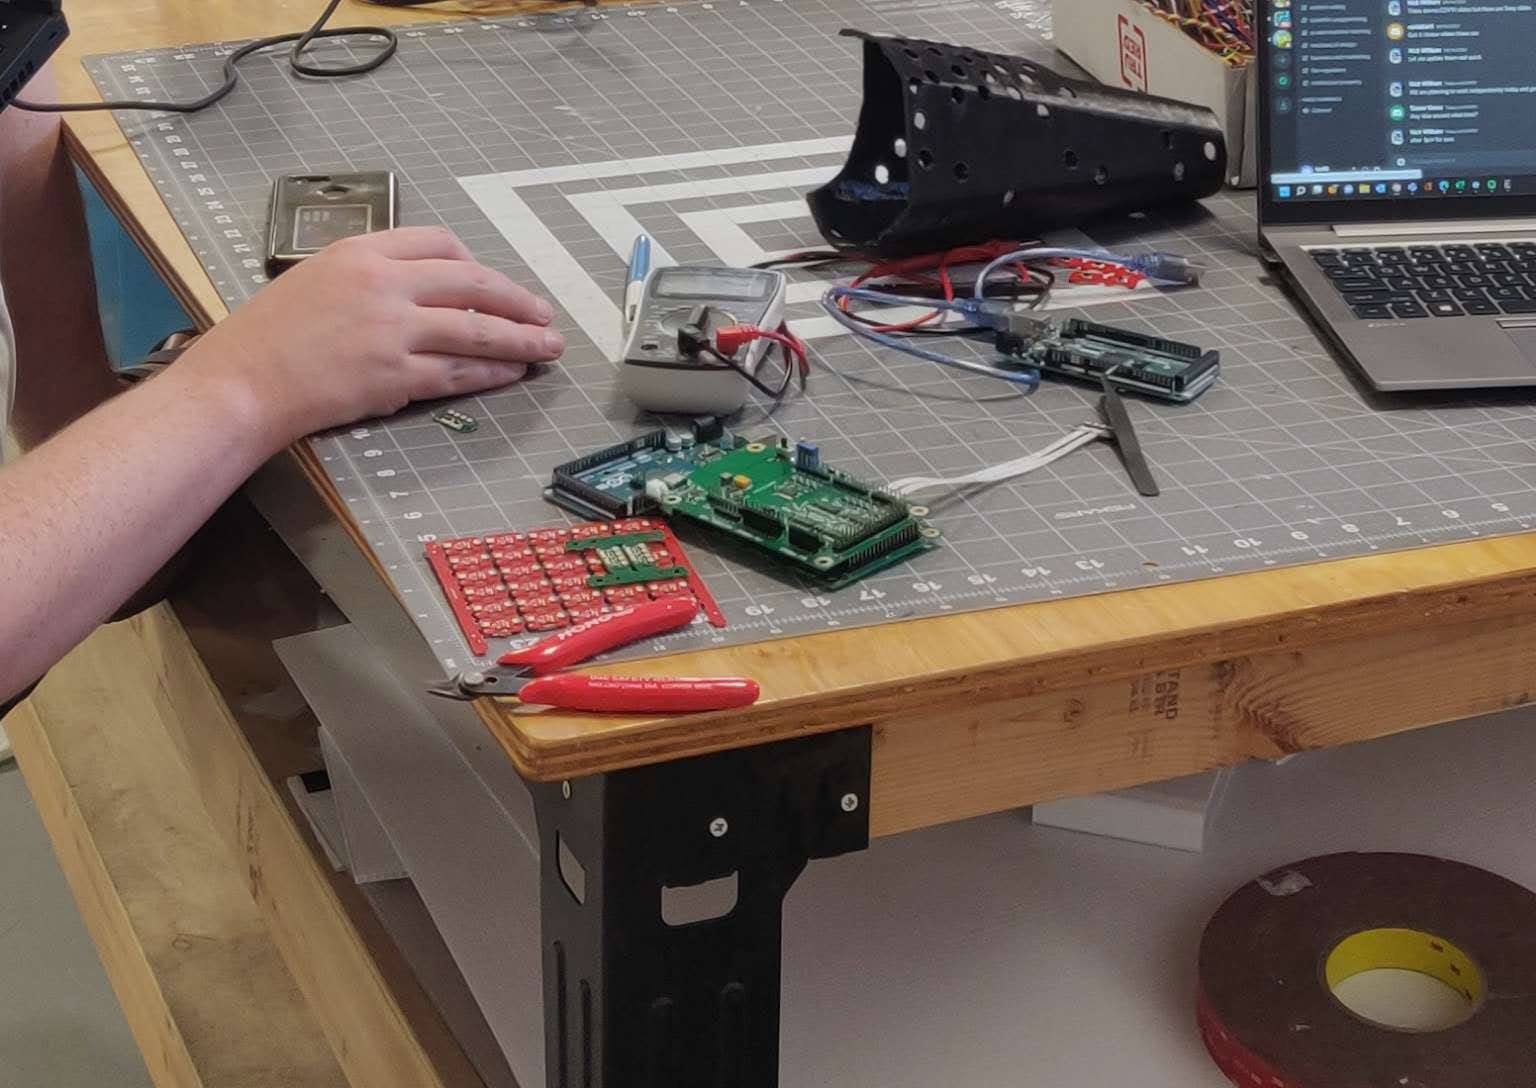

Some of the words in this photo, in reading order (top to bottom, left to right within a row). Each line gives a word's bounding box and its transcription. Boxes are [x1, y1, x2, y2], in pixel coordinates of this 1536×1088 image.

[389, 490, 409, 499] 7
[403, 511, 423, 519] 6
[418, 534, 438, 543] 5
[745, 604, 775, 616] 19
[800, 596, 832, 609] 18
[859, 589, 887, 602] 17
[912, 581, 943, 594] 16
[967, 573, 998, 586] 15
[1021, 565, 1053, 578] 14
[1074, 559, 1105, 571] 13
[1182, 543, 1208, 555] 11
[1233, 536, 1263, 550] 10
[1290, 529, 1310, 541] 9
[1340, 523, 1361, 534] 8
[1395, 516, 1412, 527] 7
[1440, 509, 1461, 520] 6
[1490, 502, 1510, 513] 5
